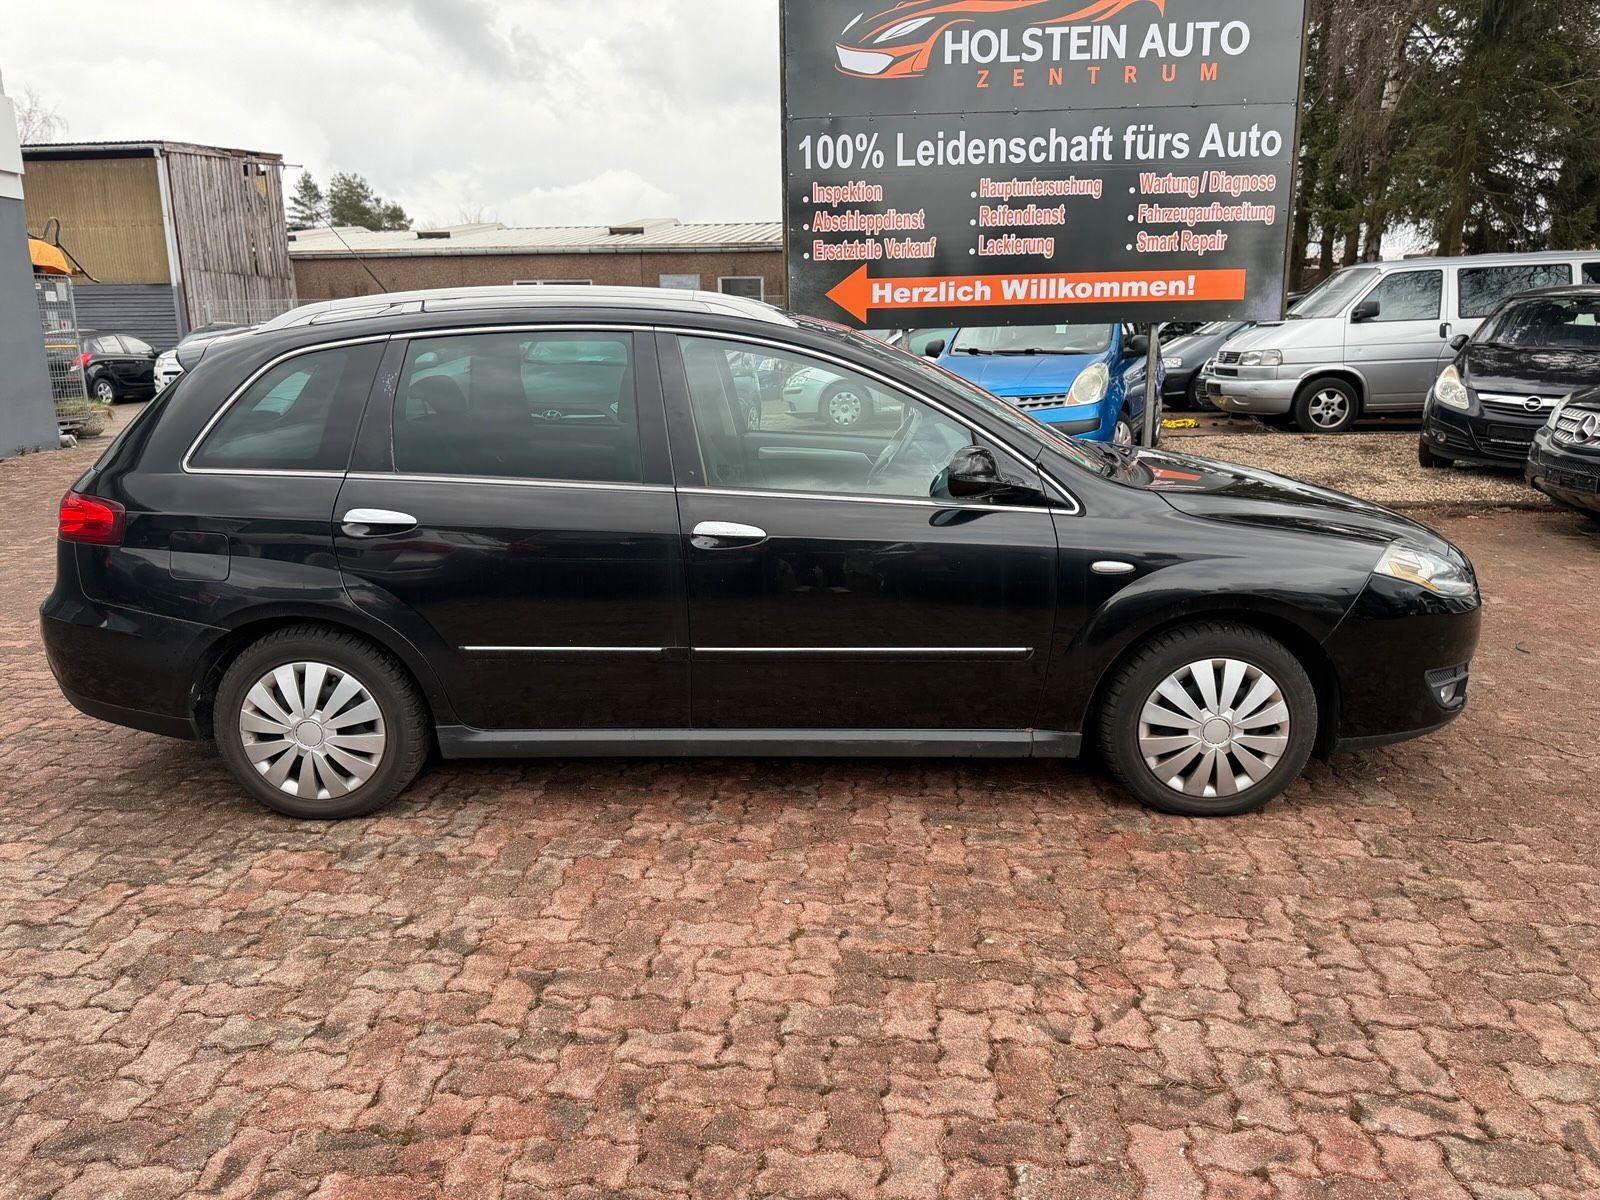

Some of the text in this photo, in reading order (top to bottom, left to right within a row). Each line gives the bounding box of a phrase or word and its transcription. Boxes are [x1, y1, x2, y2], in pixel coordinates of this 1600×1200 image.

[943, 20, 1251, 65] HOLSTEIN AUTO
[976, 62, 1218, 88] ZENTRUM
[798, 122, 1282, 170] 100% Leidenschaft fürs Auto
[812, 181, 882, 207] Inspektion
[979, 175, 1103, 201] Hauptuntersuchung
[1139, 170, 1276, 199] Wartung / Diagnose
[812, 208, 925, 235] Abschleppdienst
[979, 203, 1066, 227] Reifendienst
[1137, 202, 1275, 227] Fahrzeugaufbereitung
[812, 236, 937, 261] Ersatzteile Verkauf
[978, 233, 1055, 258] Lackierung
[1136, 229, 1228, 256] Smart Repair
[871, 274, 1195, 304] Herzlich Willkommen!
